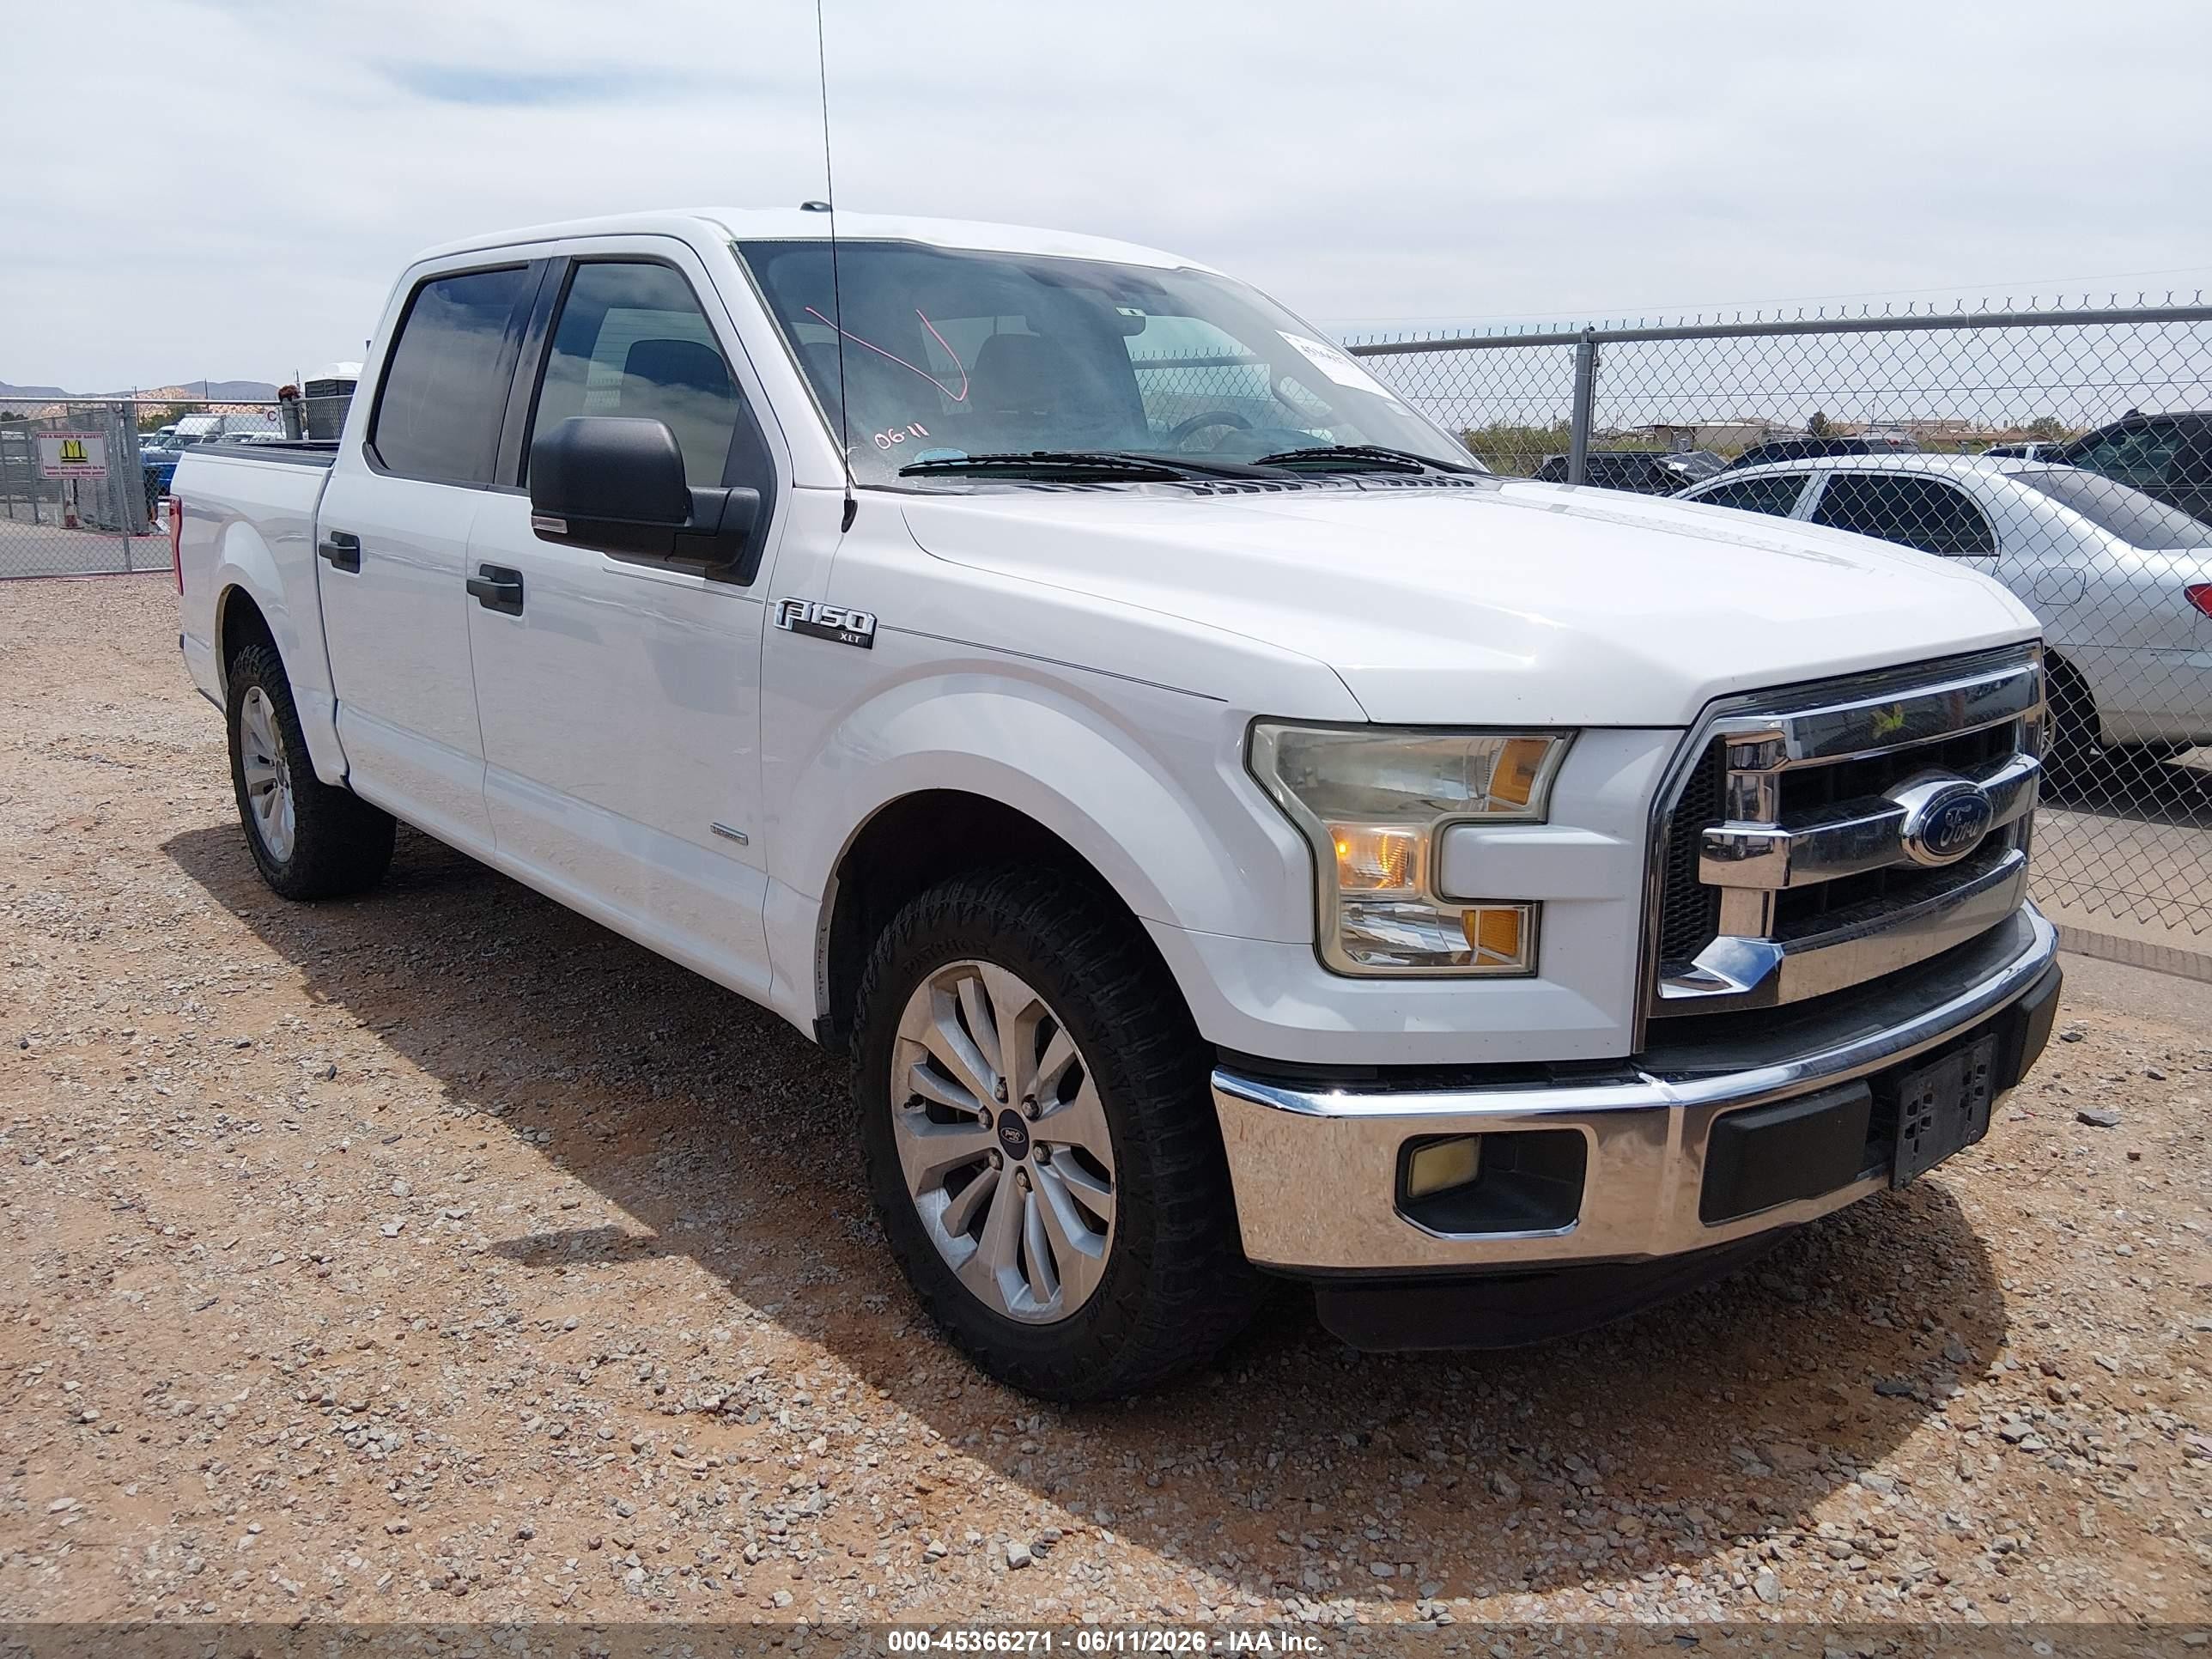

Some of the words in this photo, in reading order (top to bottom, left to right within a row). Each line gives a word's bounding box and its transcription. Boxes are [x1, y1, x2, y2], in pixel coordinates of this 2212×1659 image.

[267, 410, 277, 422] C
[840, 632, 861, 644] XLT
[1940, 804, 1982, 847] Ford
[1005, 1129, 1020, 1141] Ford
